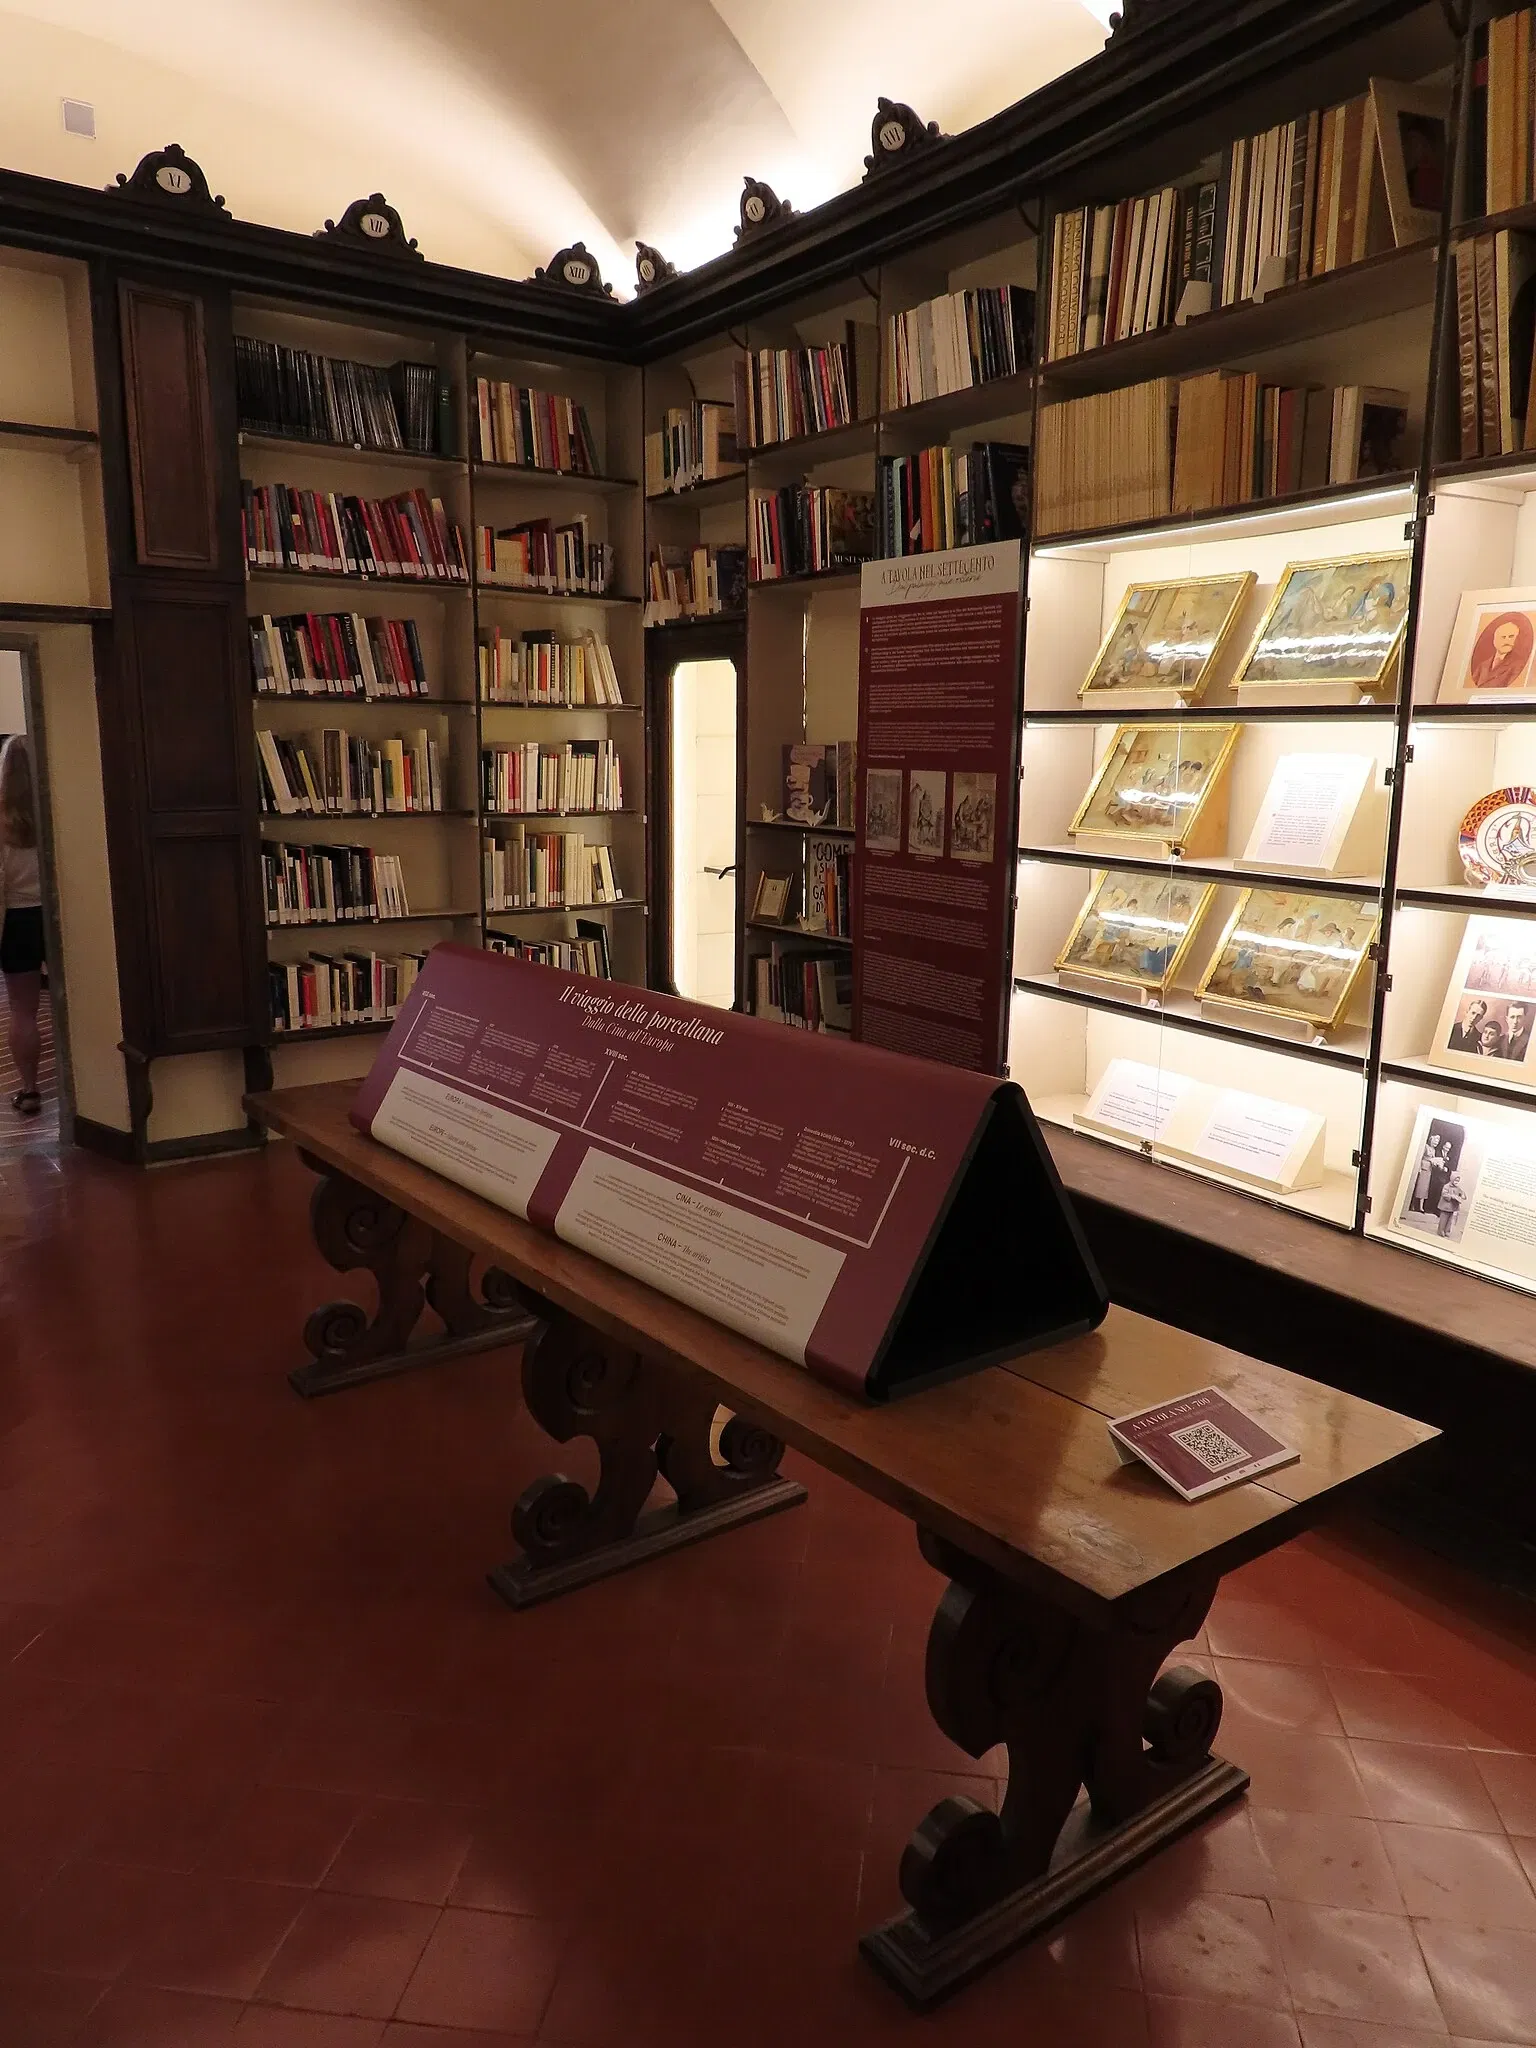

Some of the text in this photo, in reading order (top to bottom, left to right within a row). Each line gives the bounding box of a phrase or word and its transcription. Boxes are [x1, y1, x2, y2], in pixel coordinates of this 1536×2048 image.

[568, 265, 587, 280] XIII
[1057, 277, 1068, 346] LEONARDO
[1067, 275, 1080, 345] LEONARDO
[887, 566, 918, 585] TAVOLA
[919, 564, 935, 581] NEL
[936, 555, 996, 578] SETTECENTO
[343, 616, 354, 645] Duccio
[558, 985, 726, 1046] Il viaggio della porcellana
[581, 1015, 675, 1053] Dalla Cina all'Europa
[604, 1048, 629, 1062] XVIII sec.
[888, 1137, 936, 1160] VII sec. d.C.
[675, 1192, 691, 1205] CINA
[657, 1232, 678, 1249] CHINA
[1138, 1410, 1178, 1428] TAVOLA
[1174, 1404, 1196, 1415] NEL
